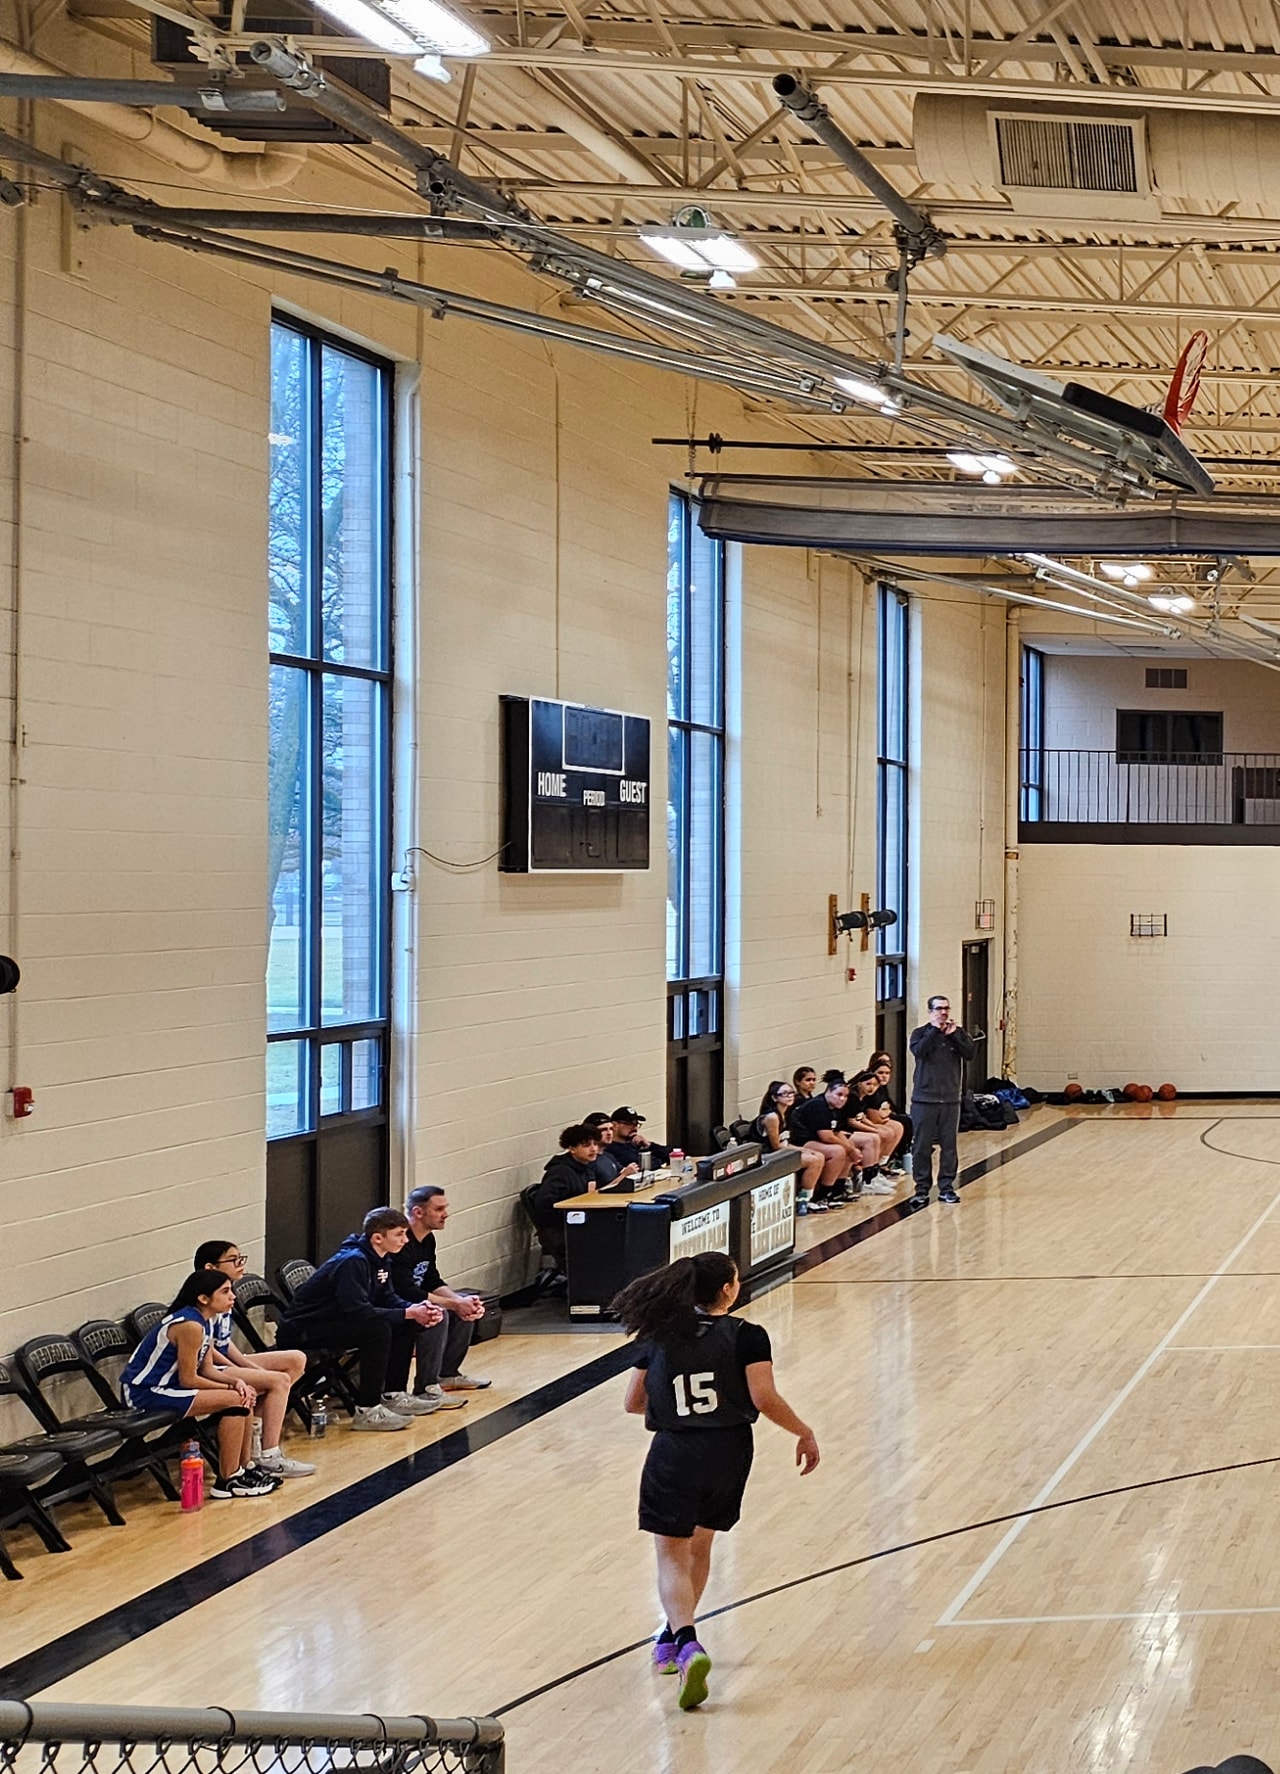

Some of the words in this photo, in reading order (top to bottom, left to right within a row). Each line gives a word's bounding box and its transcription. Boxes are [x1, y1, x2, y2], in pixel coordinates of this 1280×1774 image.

[537, 772, 567, 798] HOME
[583, 790, 606, 807] PERIOD
[619, 780, 647, 804] GUEST
[681, 1212, 710, 1236] WELCOME
[711, 1208, 720, 1222] TO
[84, 1327, 127, 1355] BEDFORD
[29, 1342, 79, 1372] BEDFORD
[673, 1372, 719, 1417] 15
